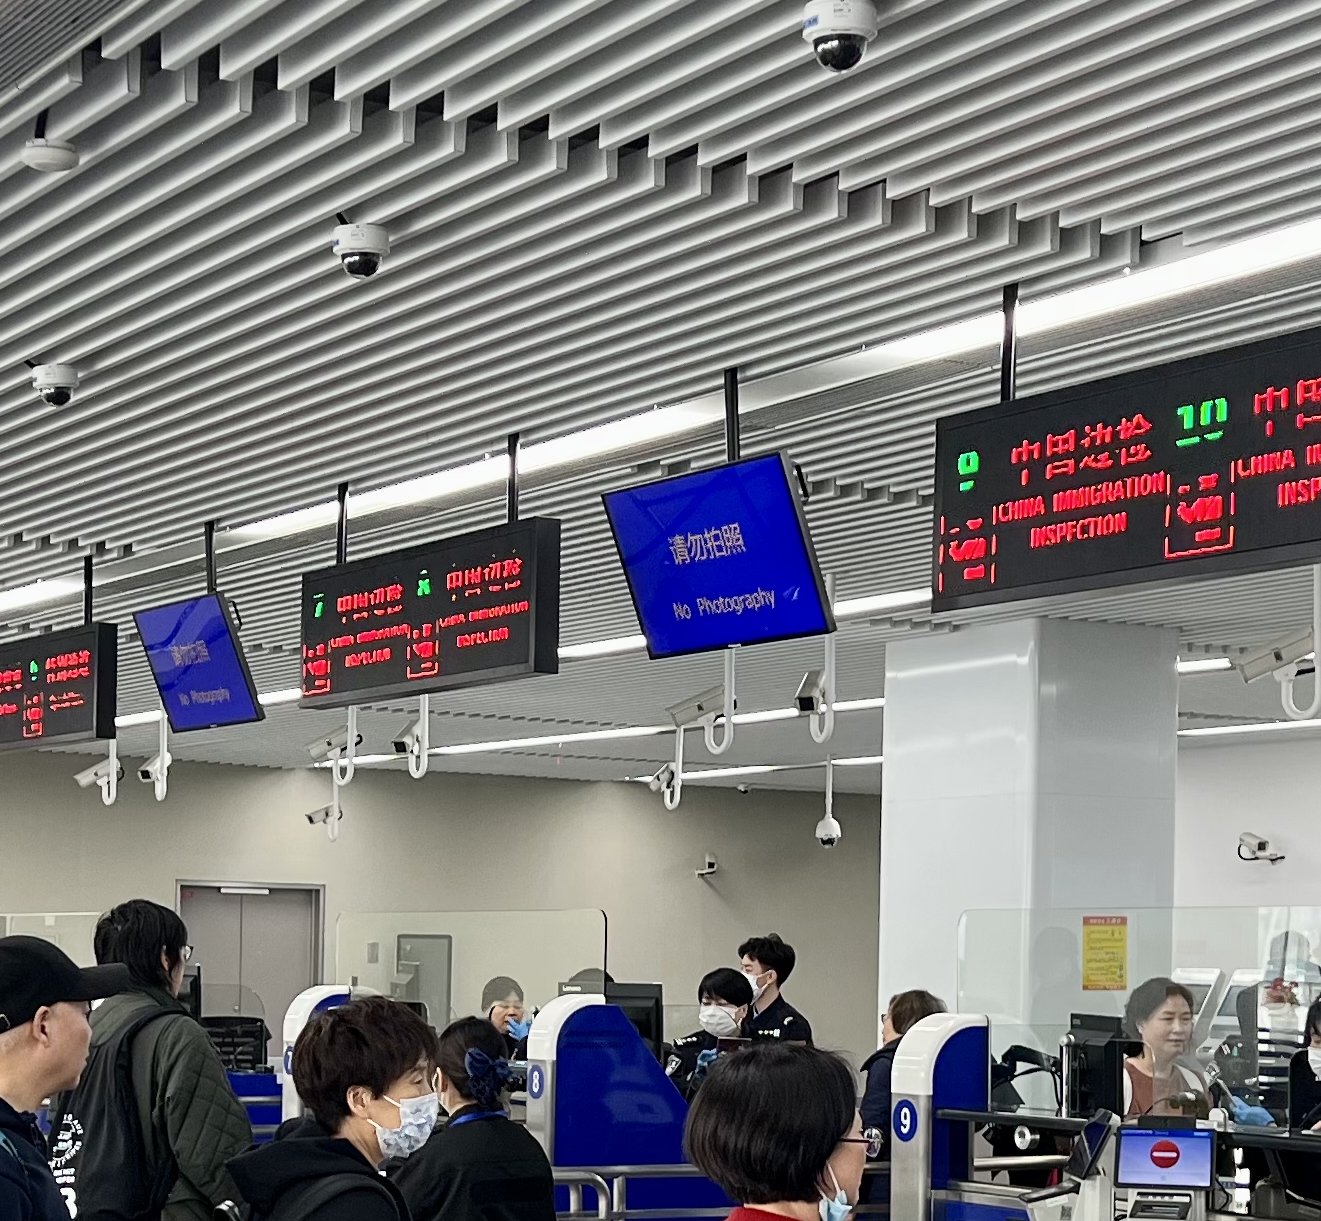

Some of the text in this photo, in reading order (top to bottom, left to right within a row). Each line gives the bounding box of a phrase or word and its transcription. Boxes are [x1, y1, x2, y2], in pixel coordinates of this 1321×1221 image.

[668, 522, 746, 565] 请勿拍照
[672, 587, 775, 620] No Photography
[532, 1072, 541, 1092] 8
[899, 1106, 911, 1134] 9
